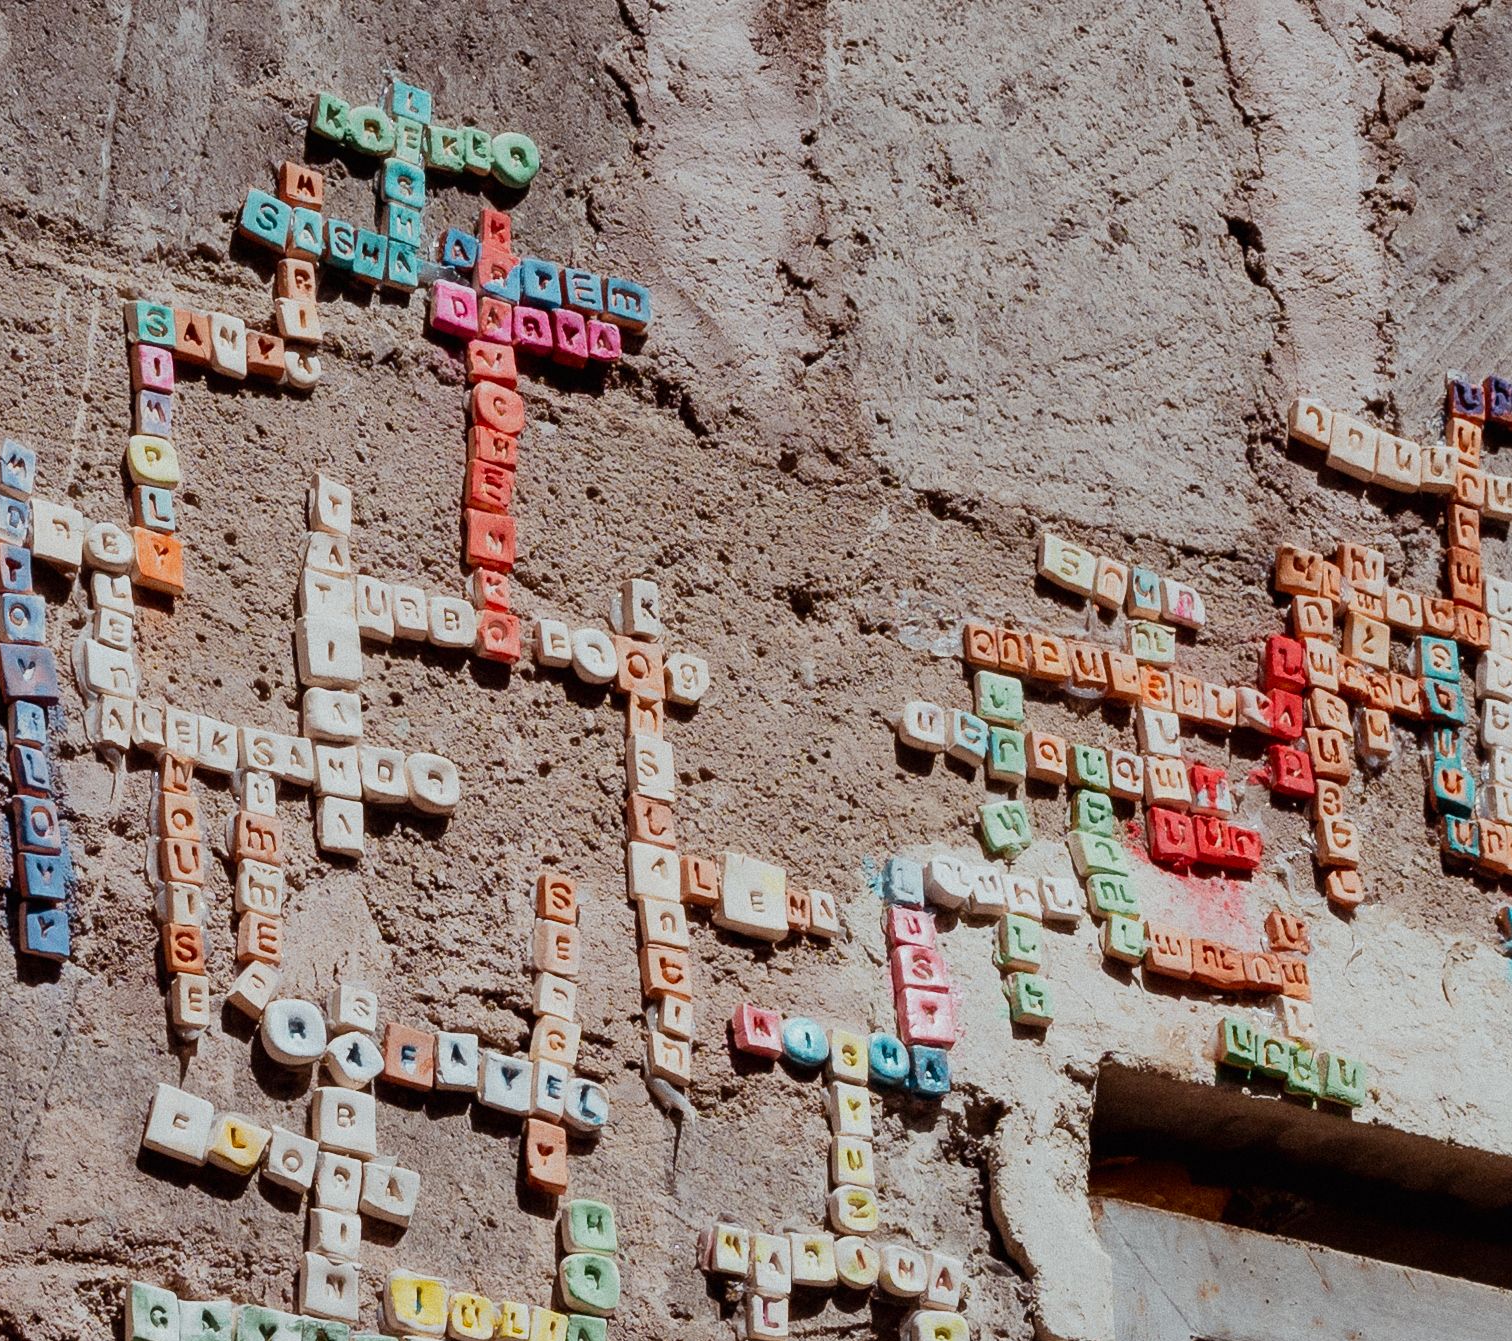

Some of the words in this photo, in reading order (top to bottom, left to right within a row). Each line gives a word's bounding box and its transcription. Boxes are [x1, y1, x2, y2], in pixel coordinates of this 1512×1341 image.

[253, 198, 421, 281] SASHA
[441, 289, 624, 359] DARYA
[135, 302, 181, 573] SIMPLY
